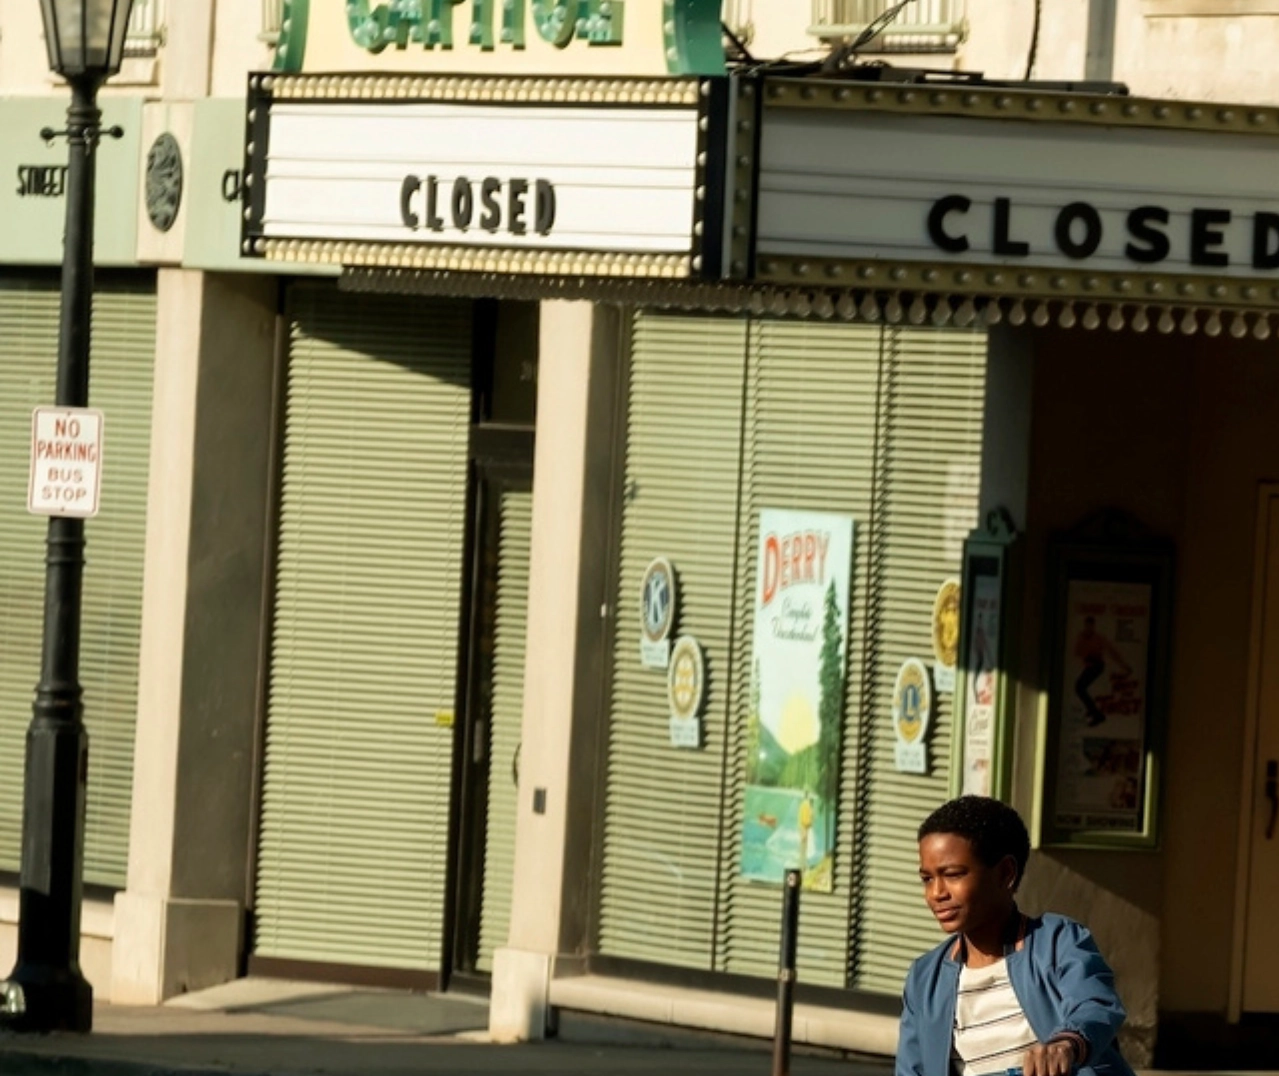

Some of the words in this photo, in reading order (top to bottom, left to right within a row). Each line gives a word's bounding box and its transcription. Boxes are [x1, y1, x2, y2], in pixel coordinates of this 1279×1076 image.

[401, 174, 556, 236] CLOSED
[55, 418, 80, 438] NO
[37, 440, 96, 462] PARKING
[48, 467, 82, 482] BUS
[42, 486, 86, 501] STOP
[761, 530, 830, 610] DERRY
